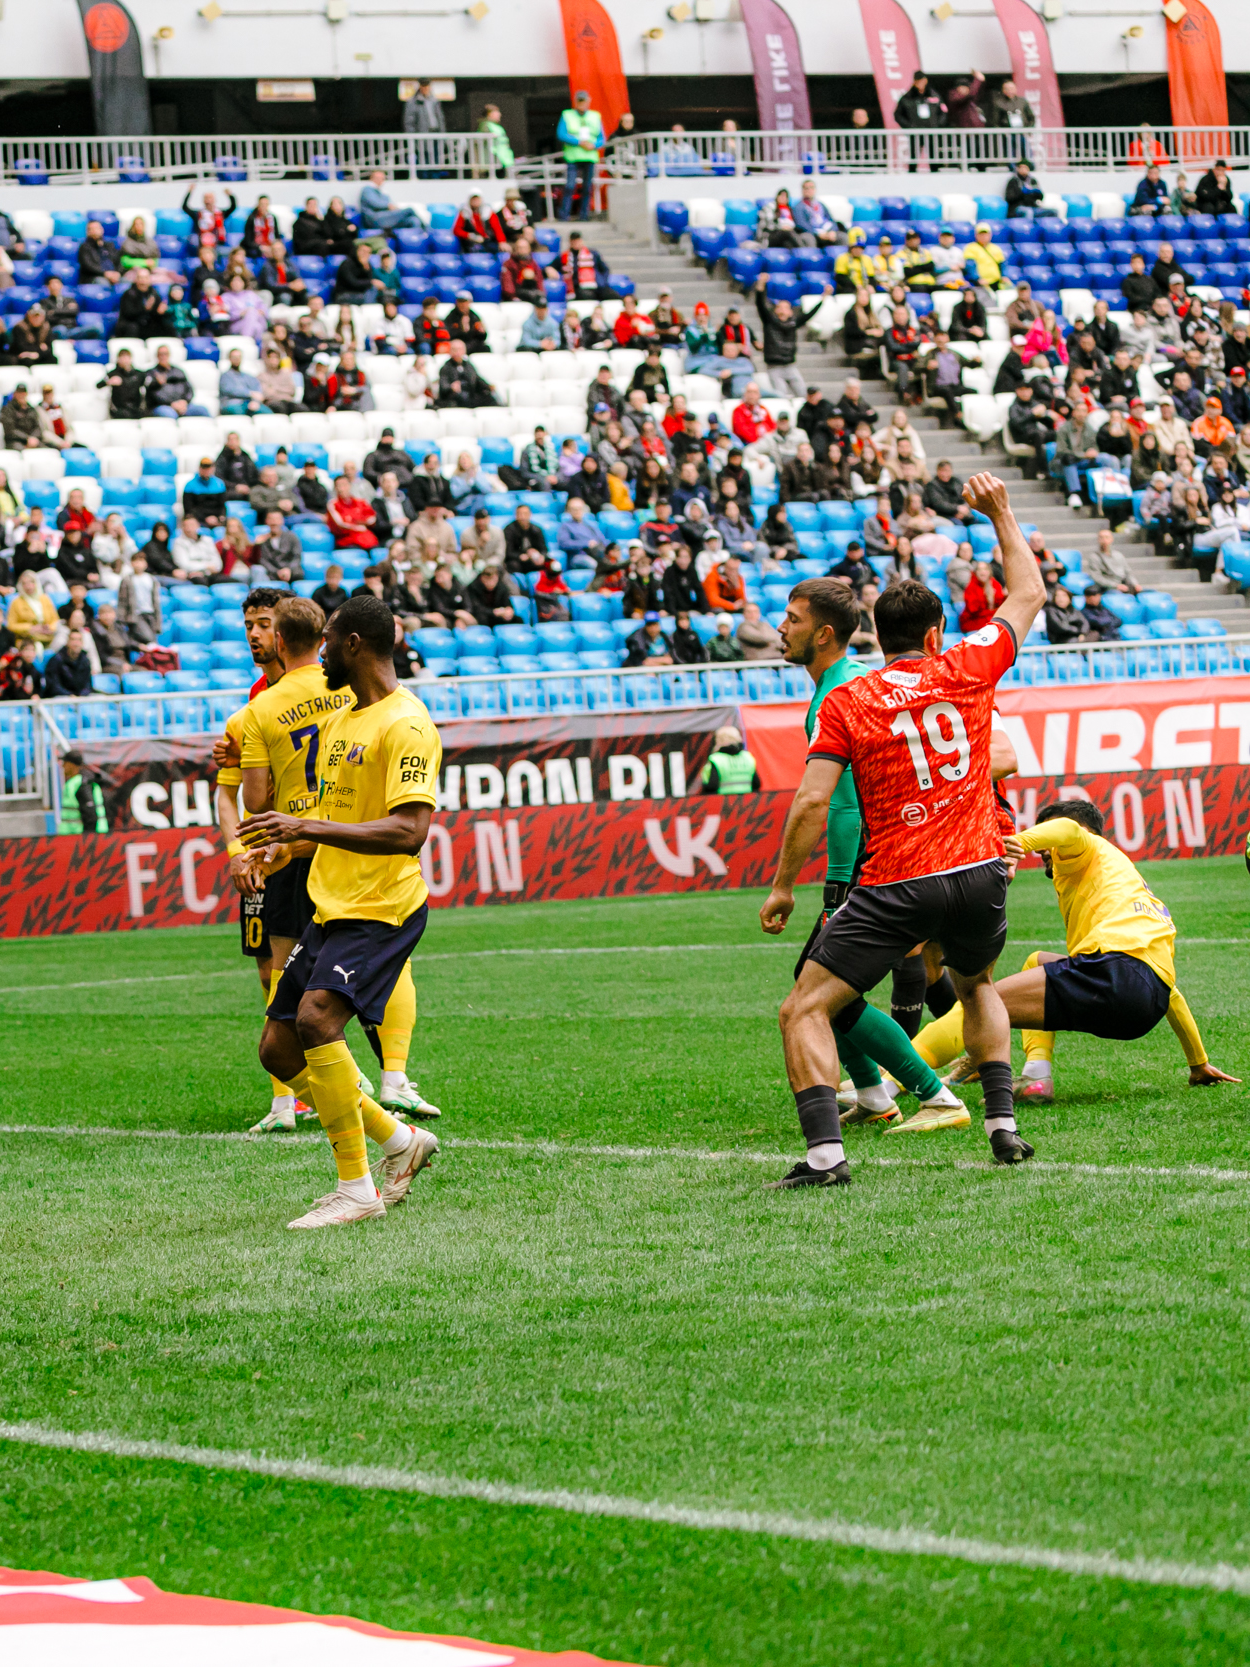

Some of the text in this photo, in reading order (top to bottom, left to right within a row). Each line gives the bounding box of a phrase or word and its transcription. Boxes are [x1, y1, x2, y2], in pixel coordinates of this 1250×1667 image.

[889, 701, 972, 791] 19
[289, 723, 320, 793] 7
[328, 754, 344, 767] BET
[400, 756, 429, 771] FON
[400, 770, 429, 784] BET
[288, 796, 319, 814] РОСТ
[125, 837, 220, 919] FC
